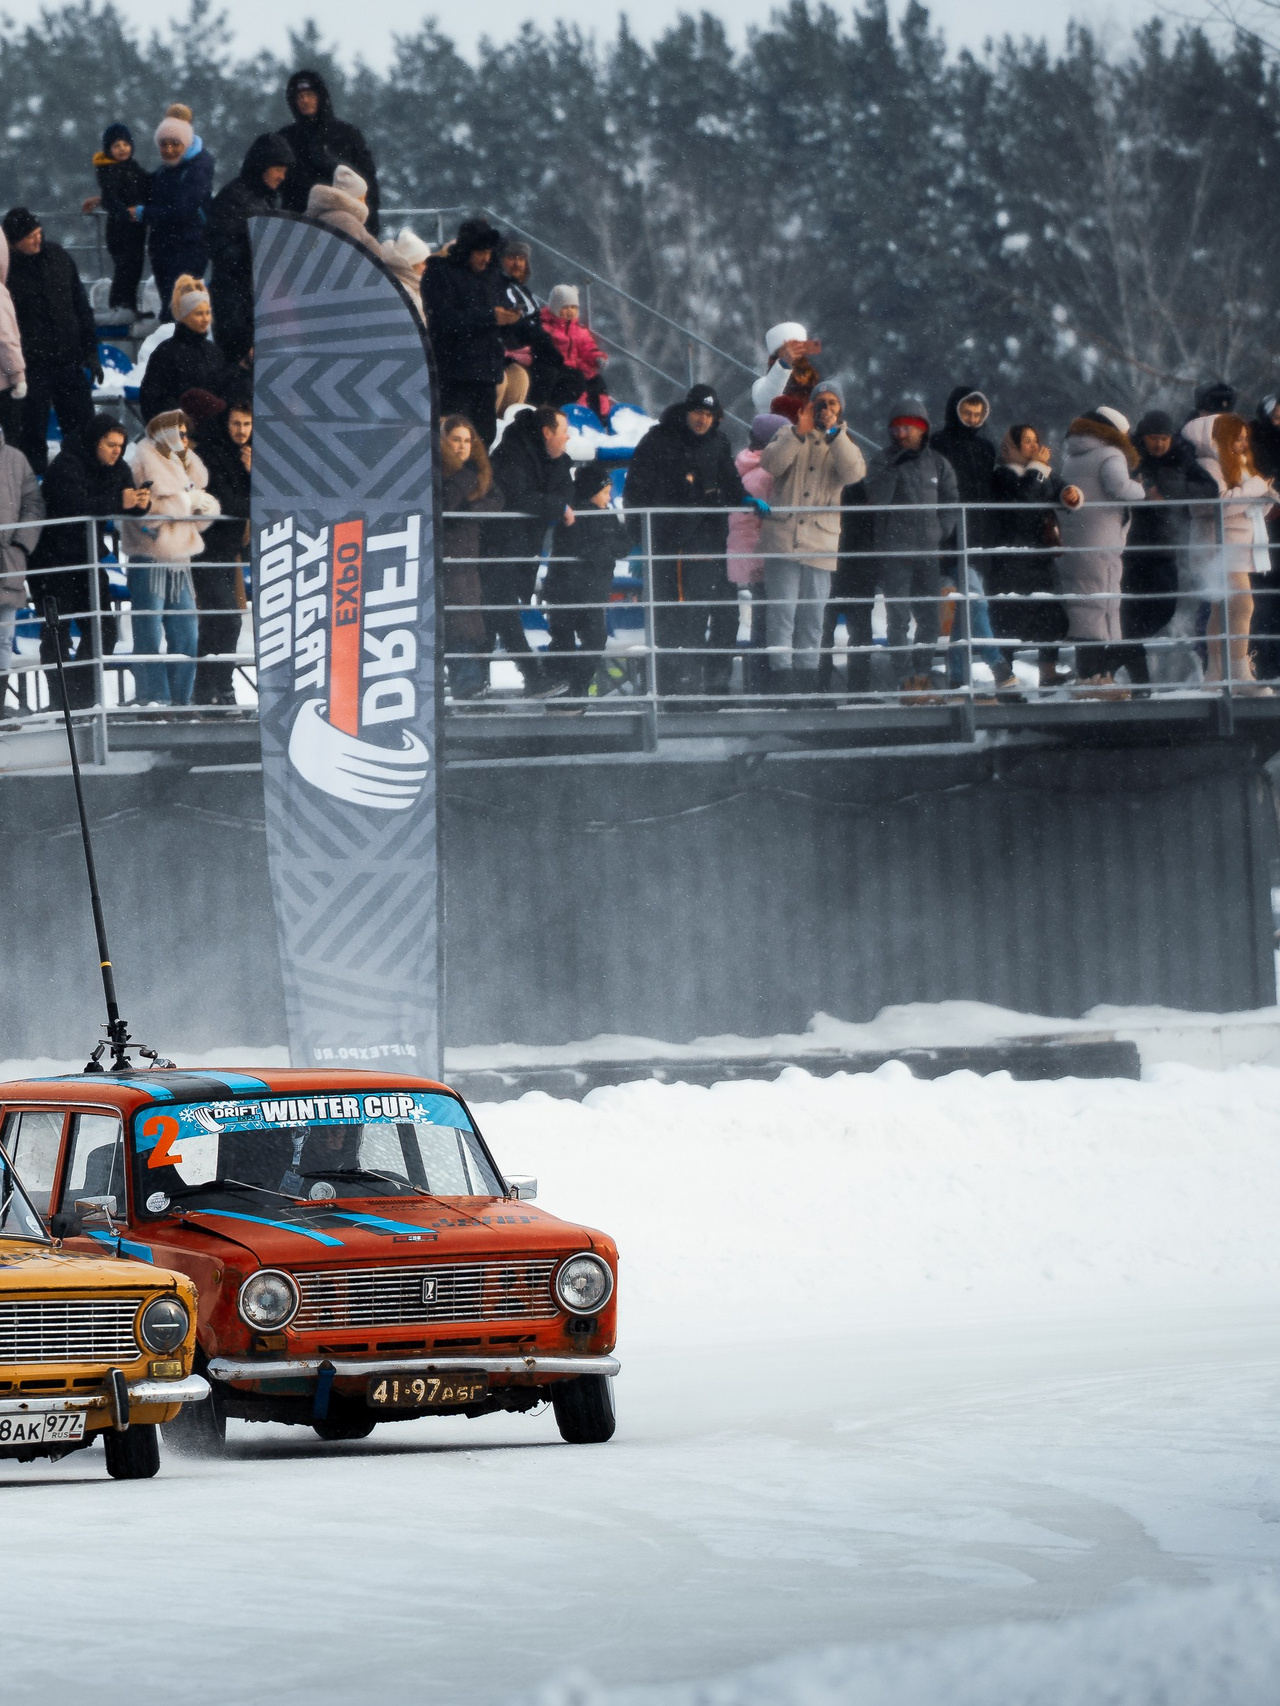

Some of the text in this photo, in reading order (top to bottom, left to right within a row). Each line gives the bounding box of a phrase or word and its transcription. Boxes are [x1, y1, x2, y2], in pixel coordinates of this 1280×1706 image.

[214, 1095, 415, 1122] DRIFT WINTER CUP
[142, 1115, 183, 1170] 2
[46, 1414, 81, 1433] 977
[51, 1431, 69, 1439] RUS
